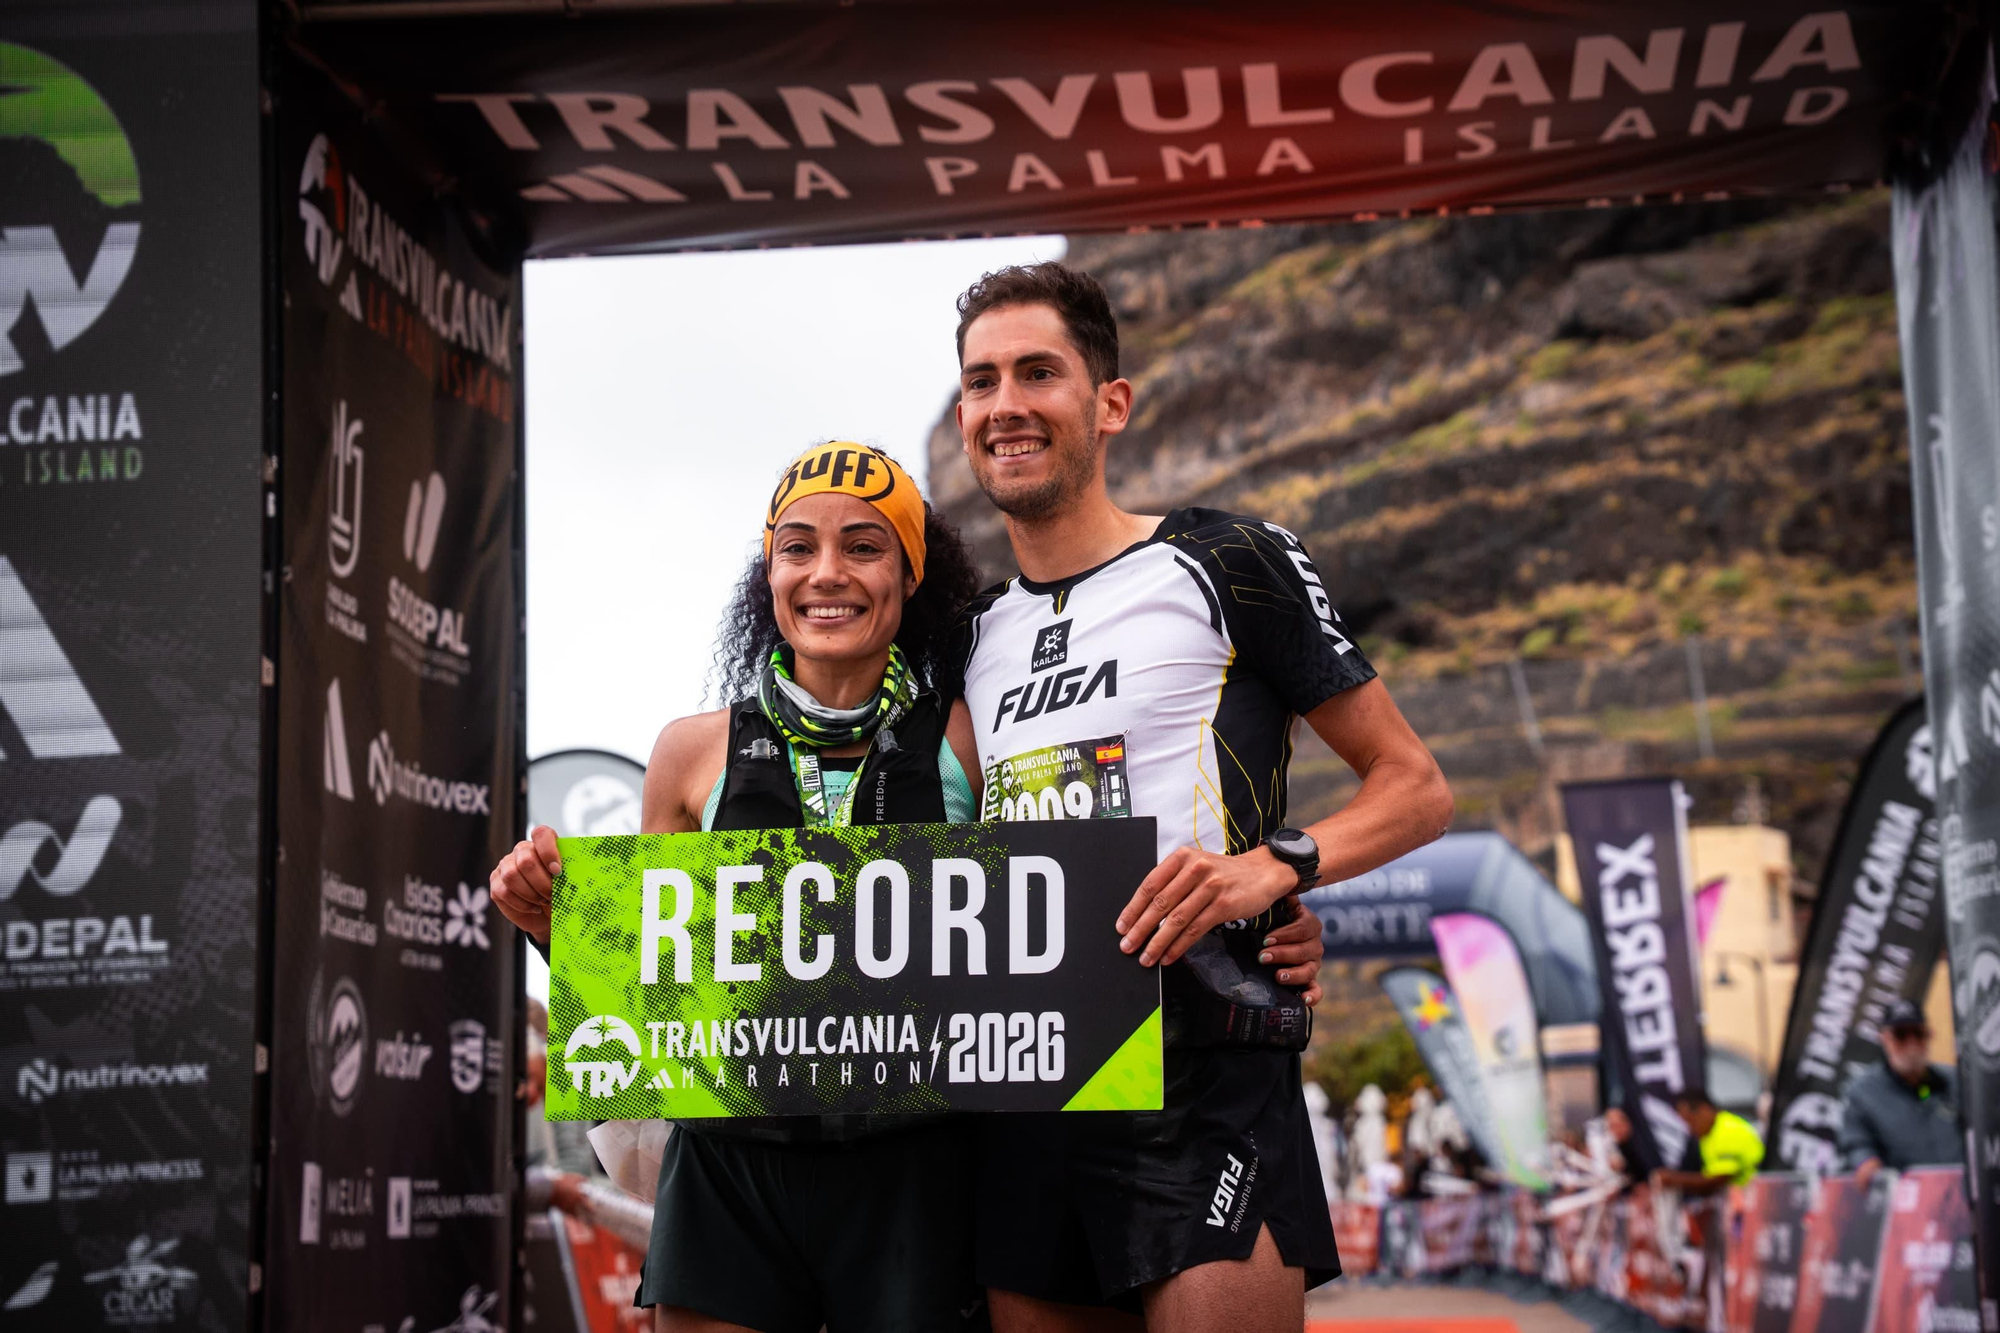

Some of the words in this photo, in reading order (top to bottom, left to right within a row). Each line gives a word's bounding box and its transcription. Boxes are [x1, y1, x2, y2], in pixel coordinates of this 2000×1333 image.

[435, 11, 1861, 151] TRANSVULCANIA
[712, 160, 851, 201] LA
[925, 138, 1314, 196] PALMA
[1404, 86, 1850, 165] ISLAND
[0, 392, 142, 446] CANIA
[24, 446, 144, 485] ISLAND
[1032, 651, 1065, 669] KAILAS
[992, 658, 1118, 734] FUGA
[1014, 747, 1081, 772] TRANSVULCANIA
[1022, 773, 1030, 782] LA
[1032, 768, 1052, 779] PALMA
[1055, 761, 1082, 774] ISLAND
[875, 771, 888, 821] FREEDOM
[0, 914, 169, 959] DEPAL
[640, 854, 1067, 985] RECORD
[1797, 800, 1923, 1080] TRANSVULCANIA
[646, 1014, 919, 1059] TRANSVULCANIA
[948, 1011, 1066, 1083] 2026
[681, 1060, 922, 1089] MARATHON
[1205, 1152, 1245, 1228] FUGA
[1246, 1155, 1259, 1182] TRAIL
[1230, 1183, 1252, 1234] RUNNING
